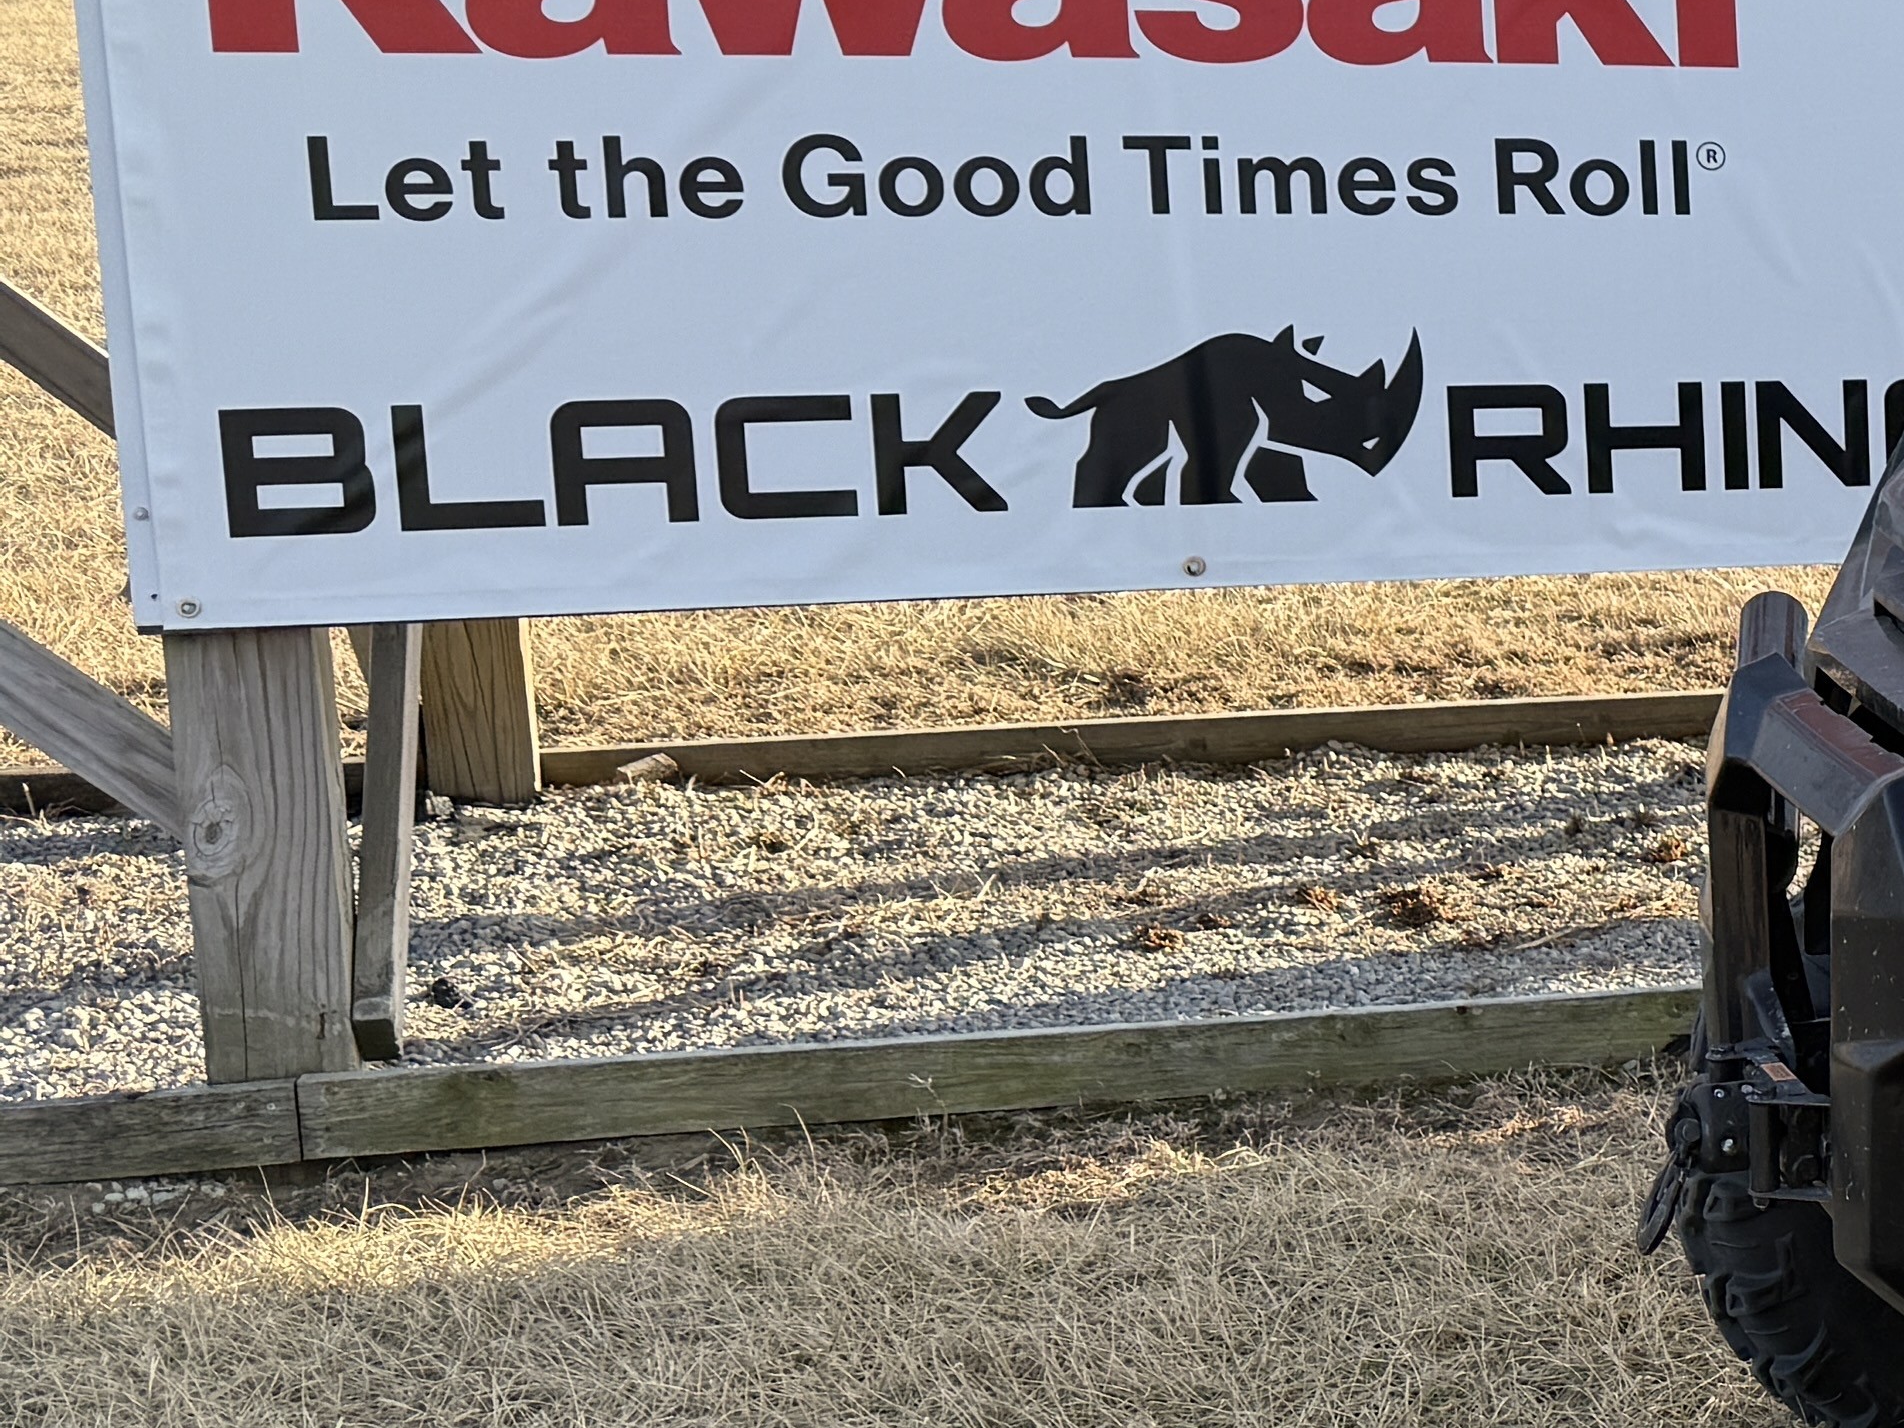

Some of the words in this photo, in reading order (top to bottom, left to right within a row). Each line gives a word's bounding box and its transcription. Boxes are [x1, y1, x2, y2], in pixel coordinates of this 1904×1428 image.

[305, 133, 505, 222] Let
[547, 133, 745, 220] the
[782, 132, 1092, 219] Good
[1122, 133, 1456, 217] Times
[217, 389, 1010, 539] BLACK
